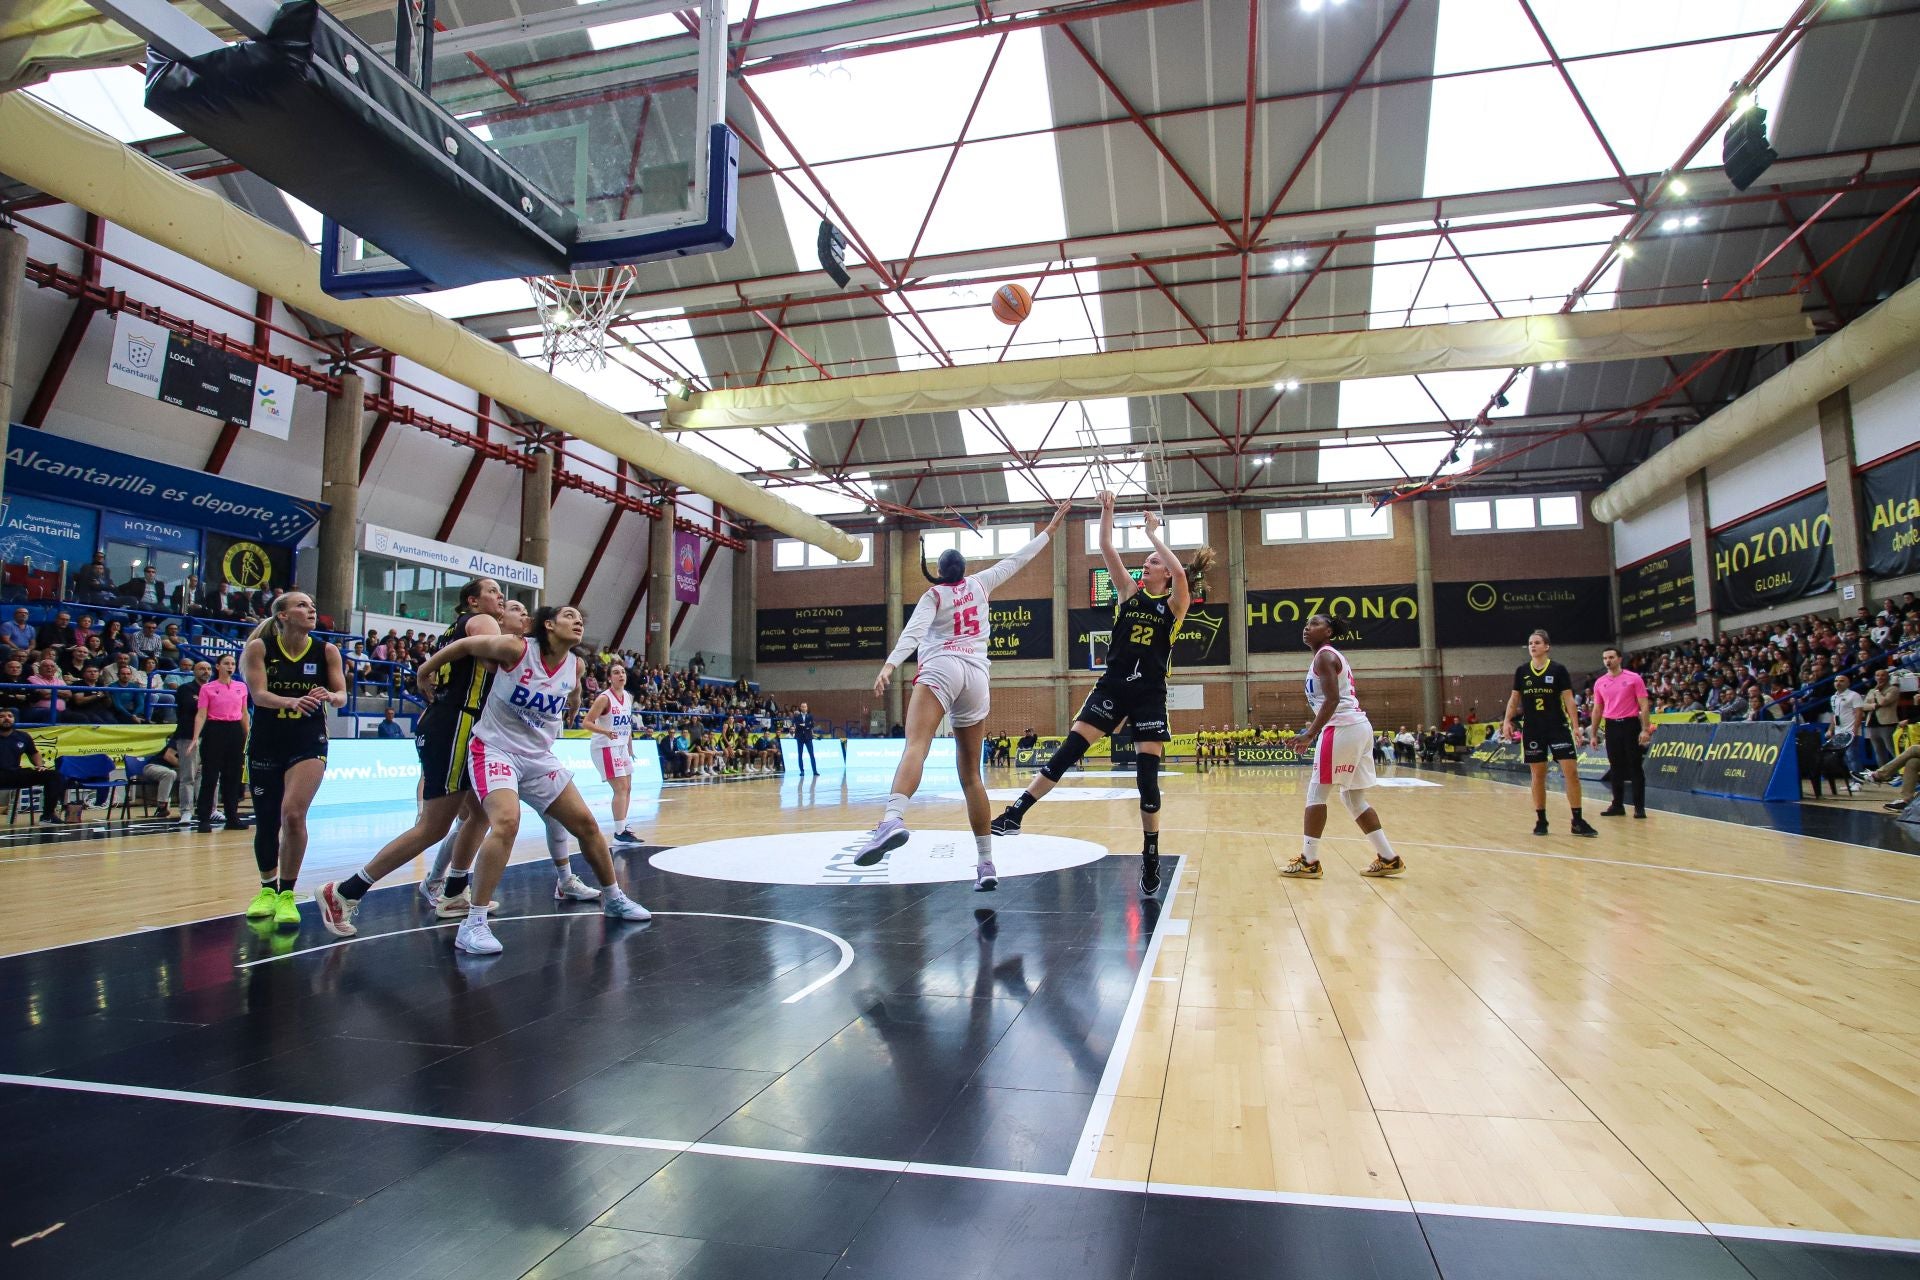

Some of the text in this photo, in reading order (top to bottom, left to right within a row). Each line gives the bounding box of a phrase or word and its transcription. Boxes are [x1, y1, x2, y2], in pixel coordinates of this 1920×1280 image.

[169, 351, 195, 367] LOCAL
[112, 362, 159, 384] Alcantarilla
[229, 372, 252, 387] VISITANTE
[164, 394, 183, 406] FALTAS
[196, 405, 218, 417] JUGADOR
[231, 416, 248, 427] FALTAS
[6, 447, 274, 522] Alcantarilla es deporte
[26, 514, 81, 529] Ayuntamiento de
[1871, 498, 1920, 532] Alca
[9, 518, 81, 540] Alcantarilla
[124, 520, 182, 539] HOZONO
[1714, 512, 1833, 581] HOZONO
[393, 541, 539, 585] Ayuntamiento de Alcantarilla
[1755, 571, 1792, 592] GLOBAL
[1503, 592, 1535, 602] Costa
[796, 608, 844, 619] HOZONO
[953, 605, 980, 636] 15
[988, 605, 1031, 621] ienda
[1247, 596, 1418, 626] HOZONO
[1129, 624, 1154, 646] 22
[519, 668, 533, 685] 2
[509, 684, 565, 714] BAXI
[1535, 698, 1545, 711] 2
[1648, 741, 1703, 761] HOZONO
[1704, 742, 1779, 765] HOZONO
